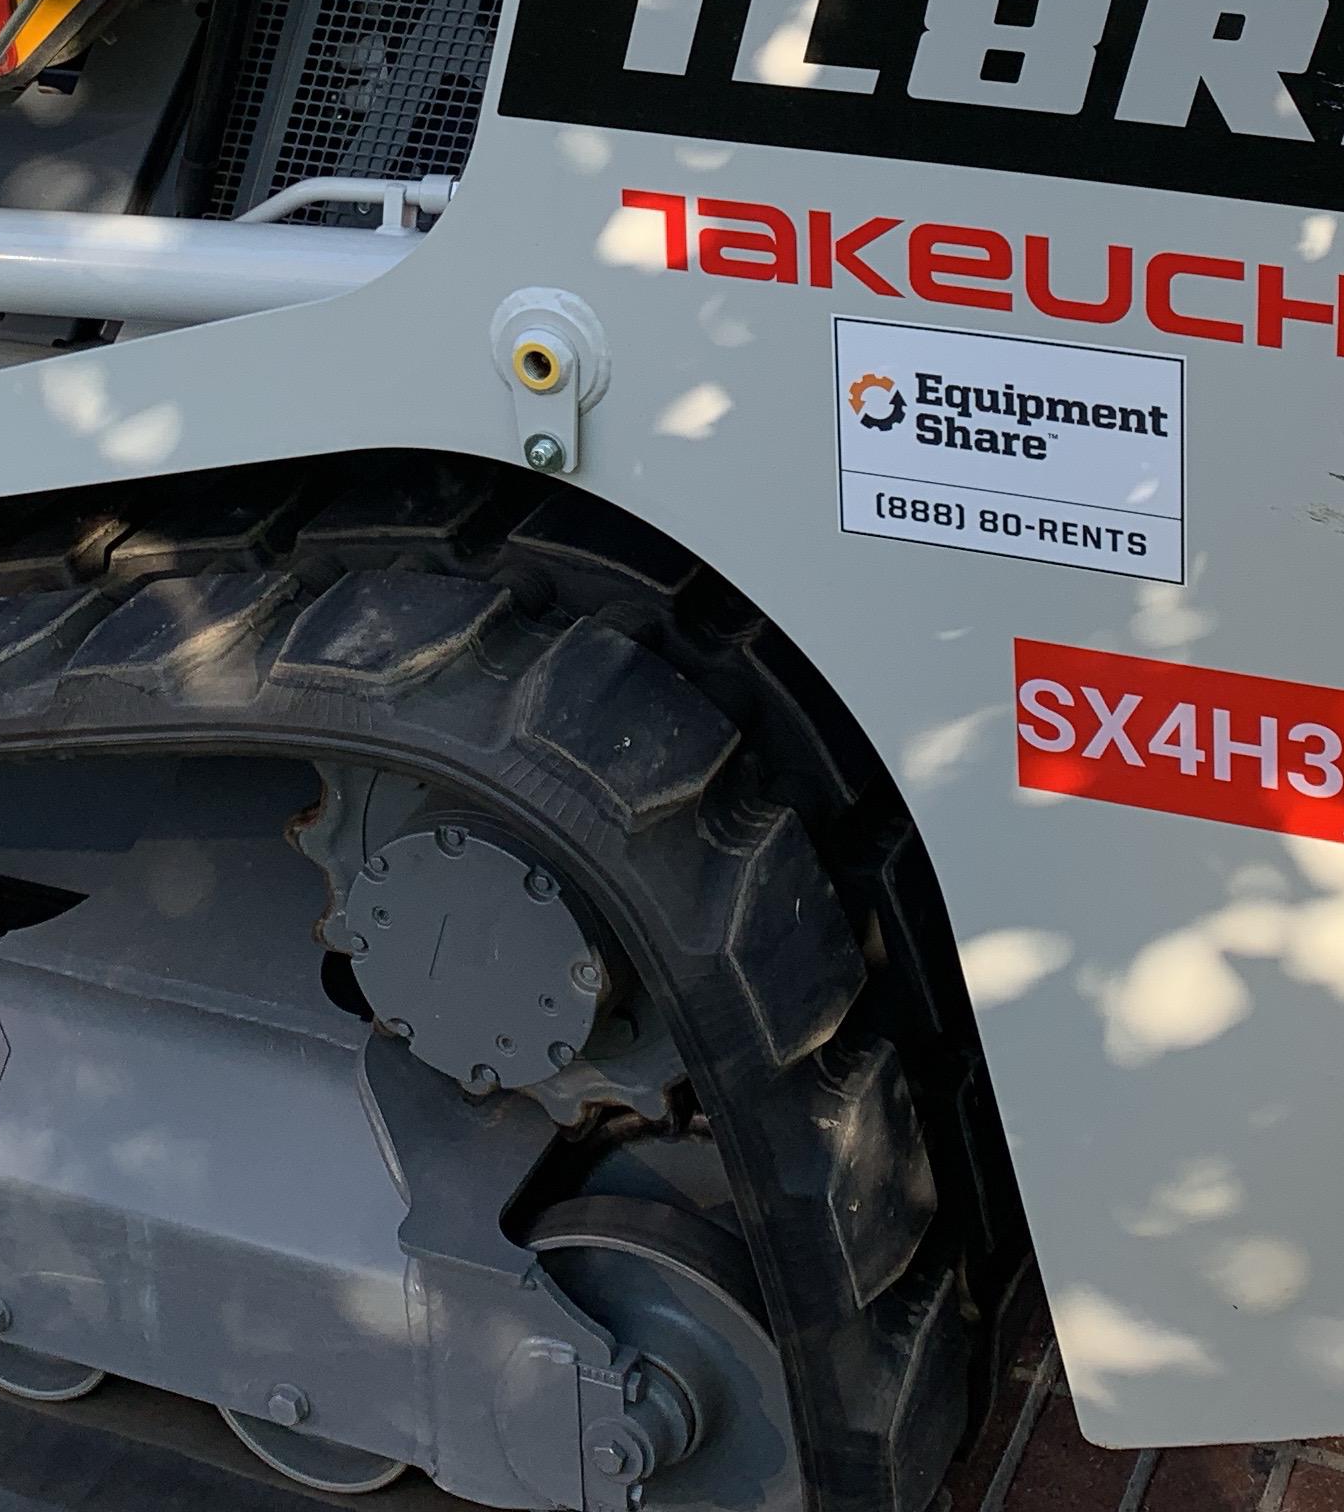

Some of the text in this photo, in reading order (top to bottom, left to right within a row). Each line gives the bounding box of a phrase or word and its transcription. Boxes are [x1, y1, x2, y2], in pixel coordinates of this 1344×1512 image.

[914, 371, 1169, 438] Equipment
[915, 412, 1048, 461] Share
[875, 492, 1148, 558] (888) 80-RENTS
